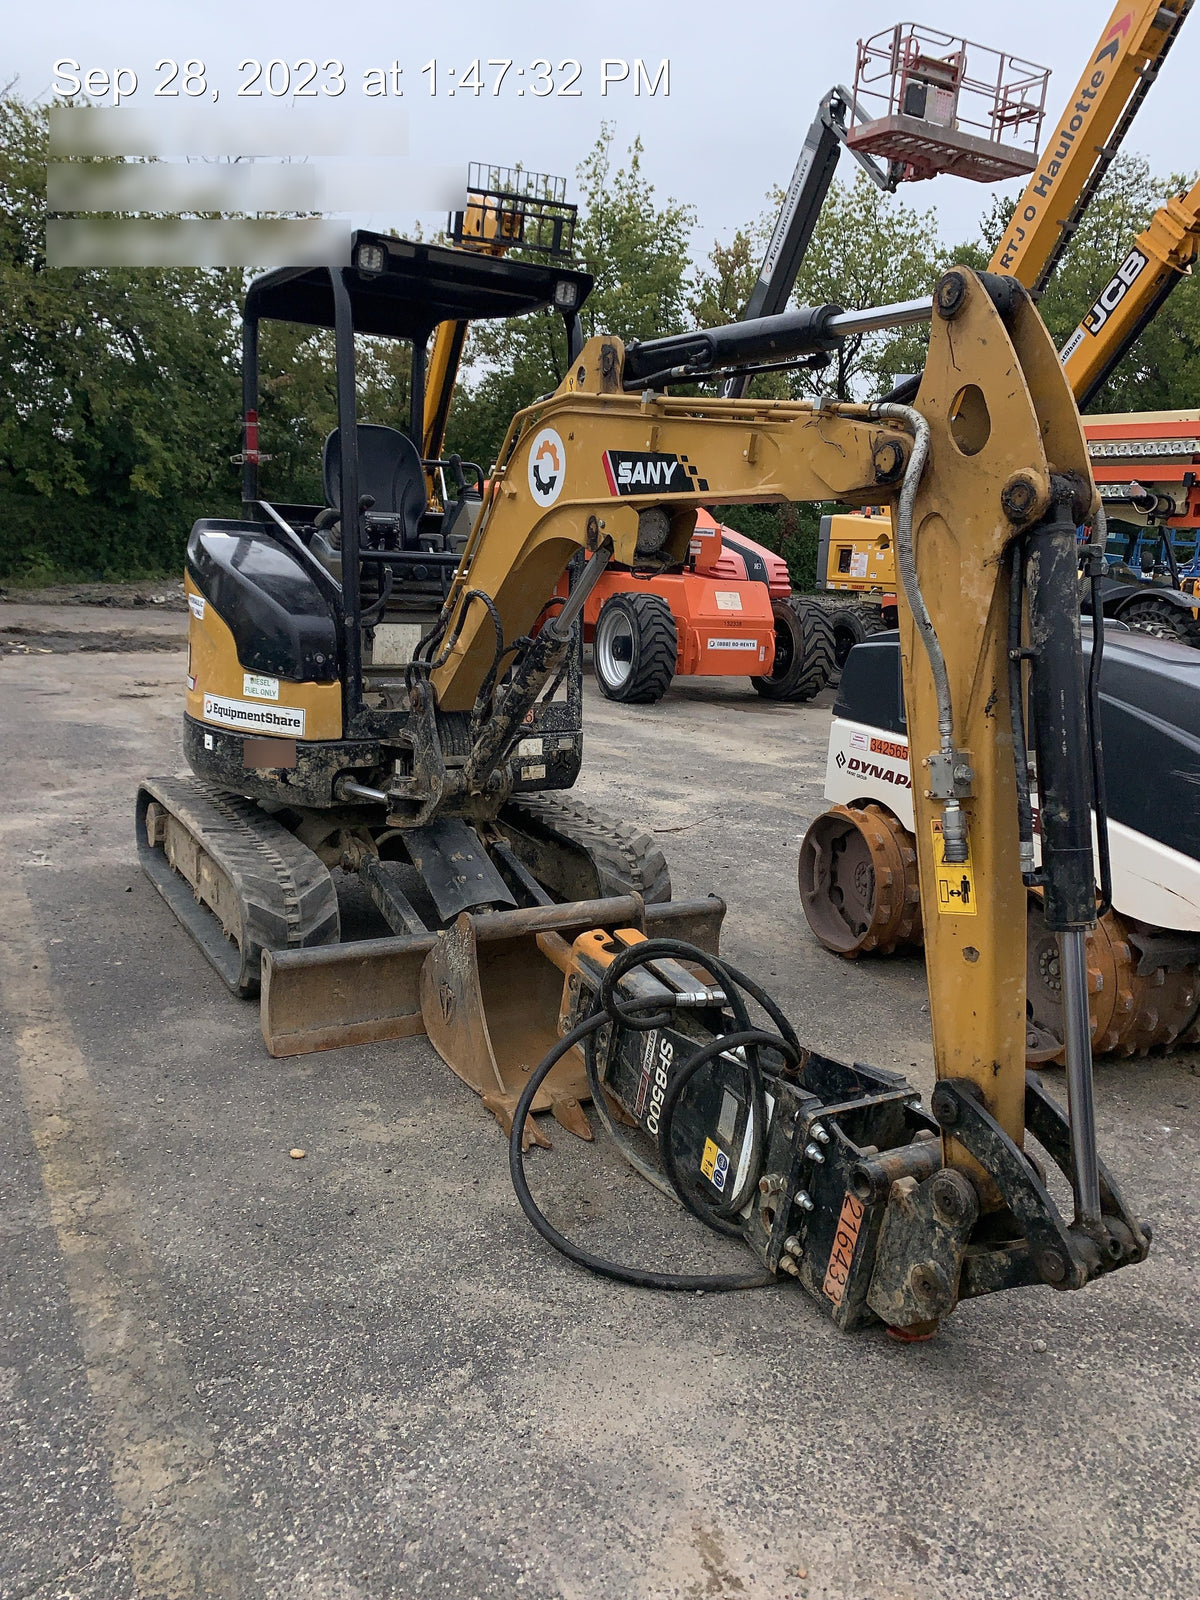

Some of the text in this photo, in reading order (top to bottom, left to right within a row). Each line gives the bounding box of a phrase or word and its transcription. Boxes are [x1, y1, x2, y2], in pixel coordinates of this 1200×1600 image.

[999, 226, 1026, 270] RTJ
[1032, 69, 1105, 199] Haulotte
[769, 158, 808, 262] EquipmentShare
[1089, 250, 1146, 333] JCB
[617, 461, 678, 485] SANY
[245, 686, 277, 697] FUEL ONLY
[249, 677, 271, 687] DIESEL
[213, 702, 301, 728] EquipmentShare
[870, 737, 909, 761] 342565
[646, 1037, 674, 1135] SFB500
[824, 1194, 863, 1302] 216433
